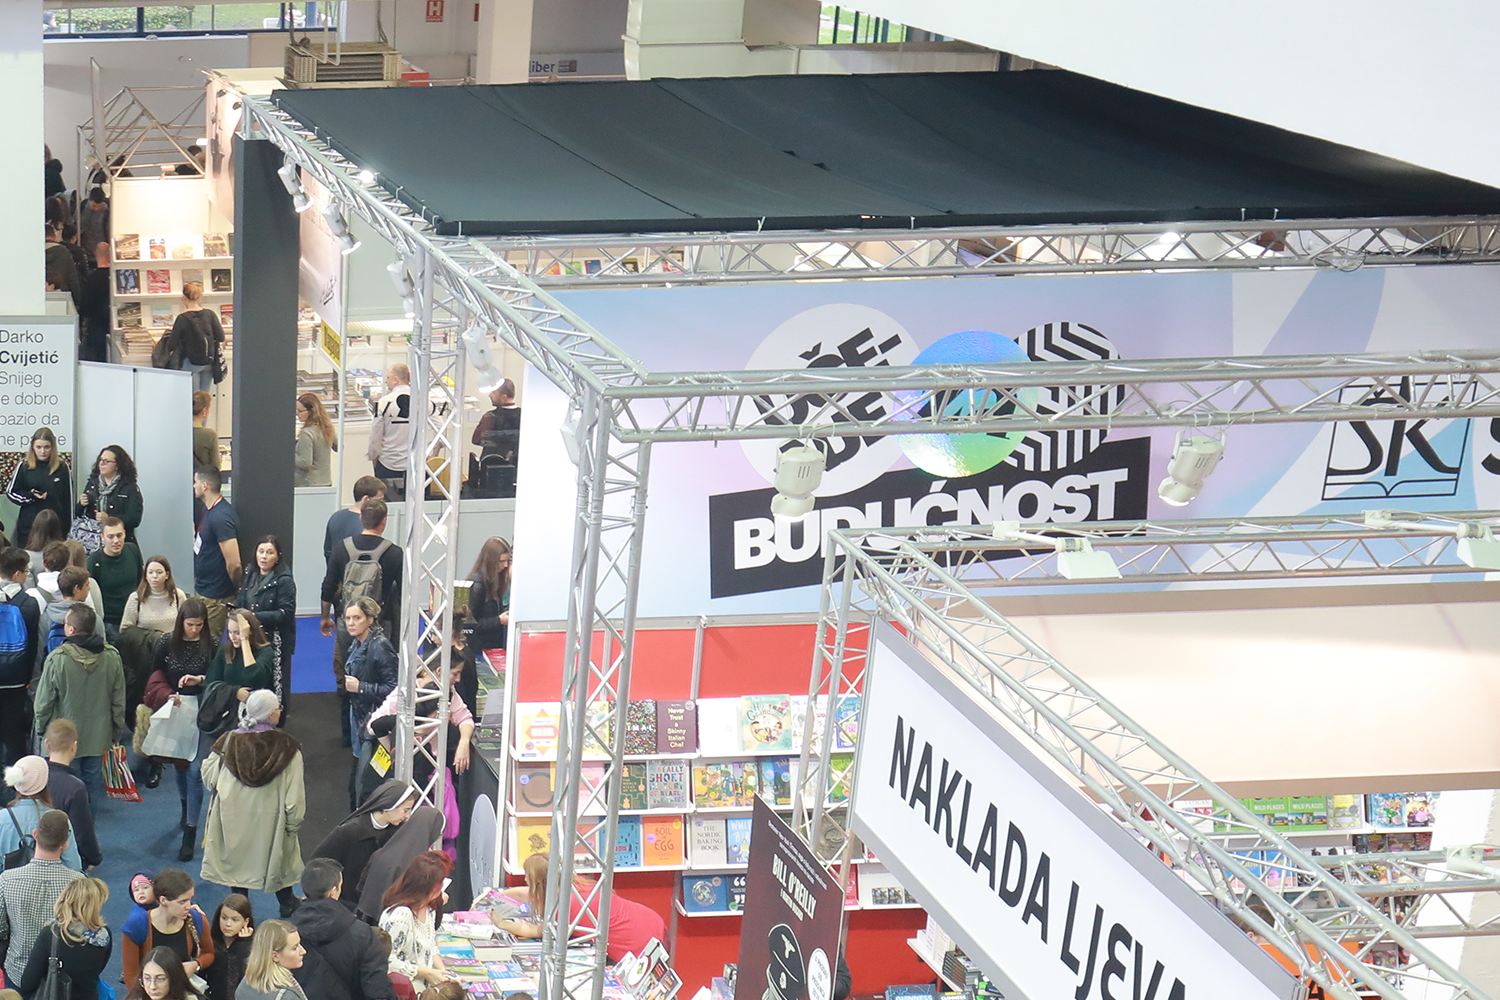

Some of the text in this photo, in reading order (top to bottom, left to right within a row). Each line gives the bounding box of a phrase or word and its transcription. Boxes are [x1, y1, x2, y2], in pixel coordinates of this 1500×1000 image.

[14, 392, 59, 405] dobro
[41, 412, 60, 426] da
[733, 467, 1129, 571] BUDUĆNOST
[667, 728, 687, 736] Skinny
[1254, 803, 1285, 811] WILD PLACES
[1292, 802, 1324, 810] WILD PLACES
[655, 827, 672, 836] BOIL
[697, 831, 723, 839] NORDIC
[888, 714, 1051, 945] NAKLADA
[654, 840, 674, 851] EGG
[772, 853, 788, 888] BILL
[787, 871, 817, 920] O'REILLY
